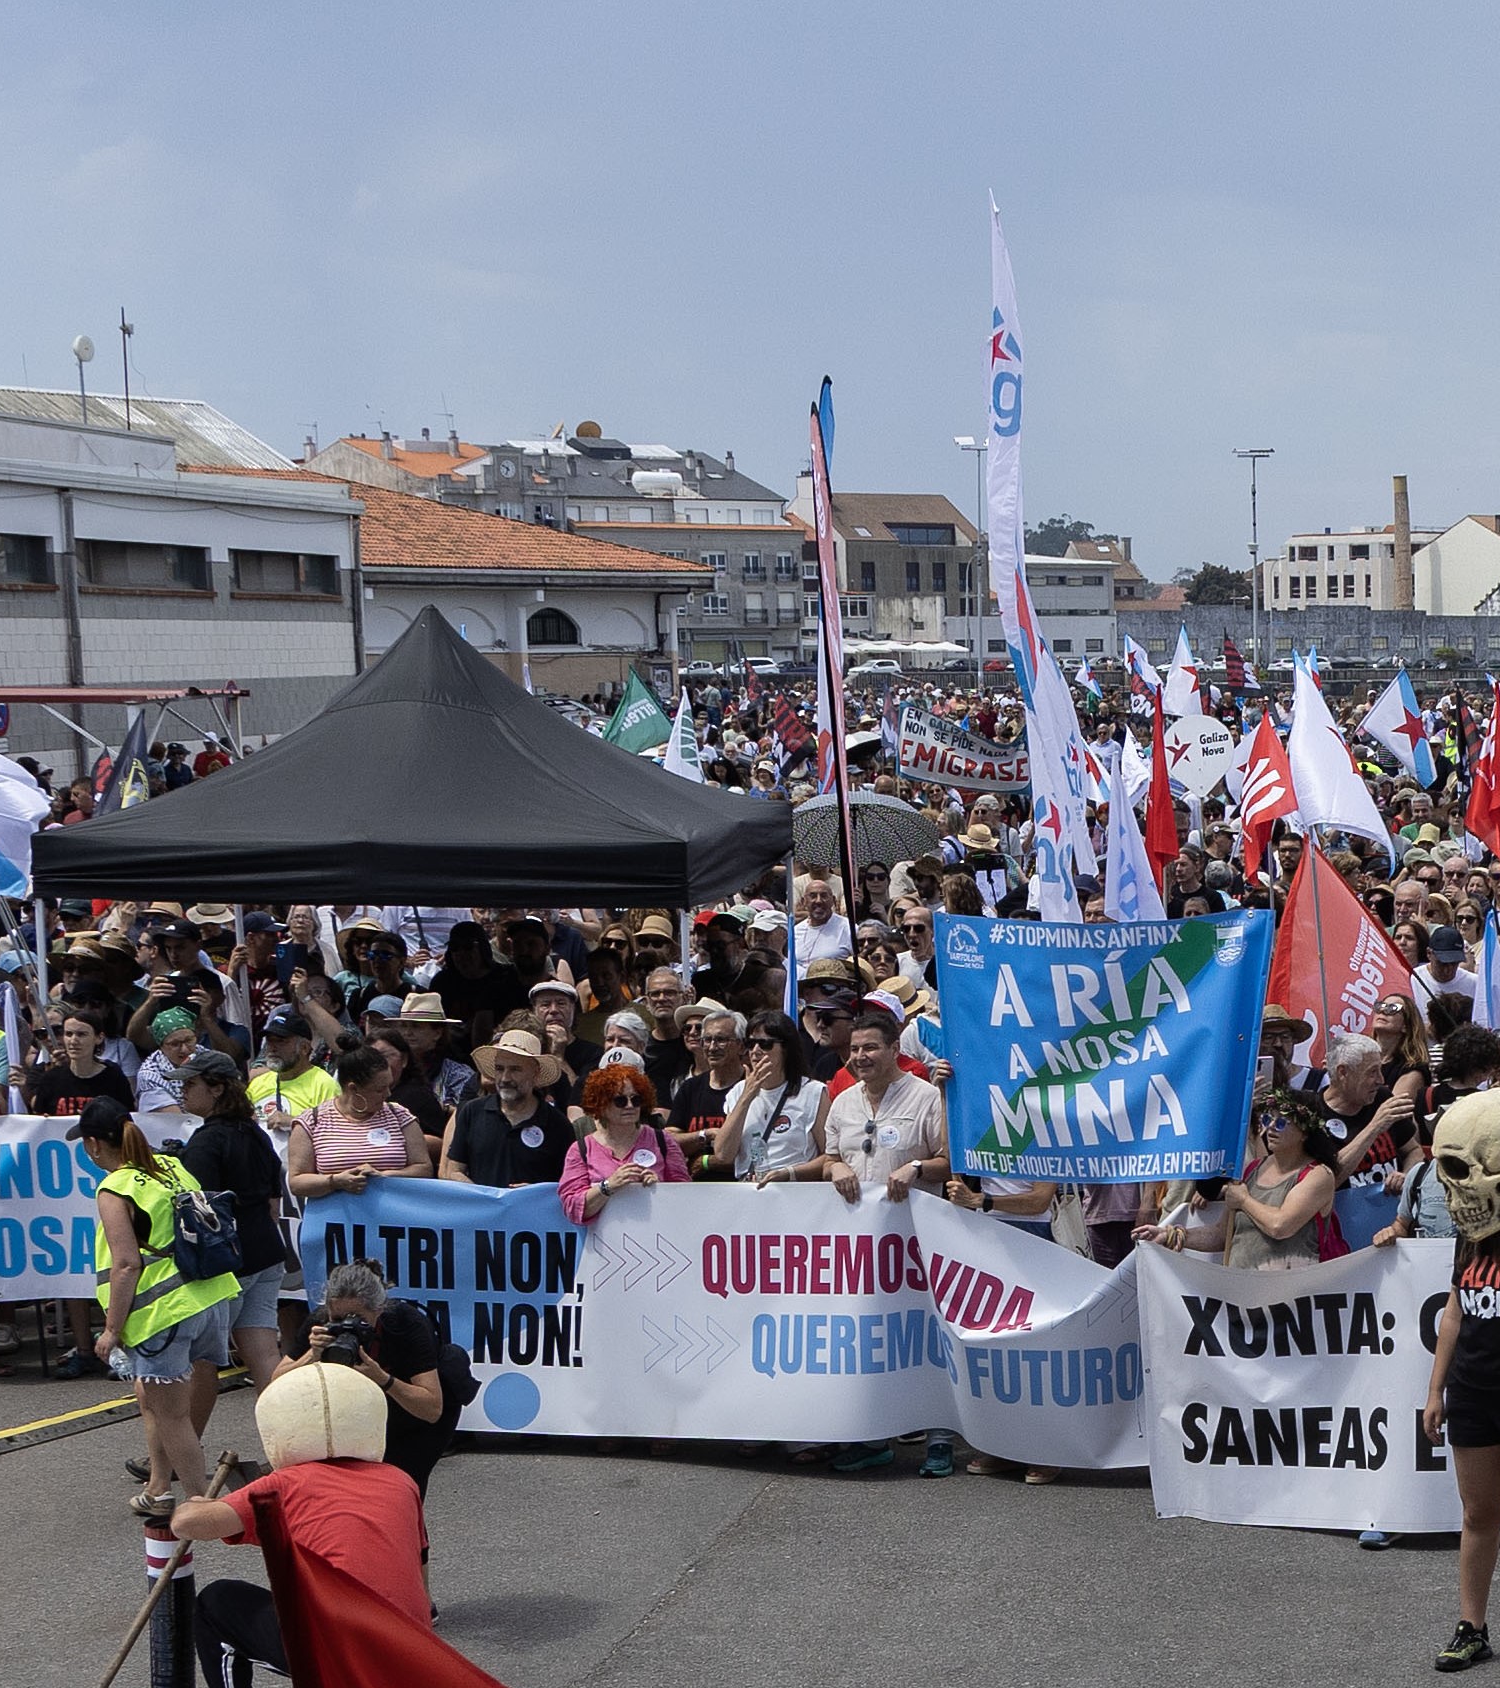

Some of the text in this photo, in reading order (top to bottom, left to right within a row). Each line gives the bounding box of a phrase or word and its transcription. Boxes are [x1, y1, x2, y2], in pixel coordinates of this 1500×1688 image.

[904, 721, 977, 754] NON SE PIDE
[906, 709, 923, 723] EN
[1199, 732, 1230, 745] Galiza
[1201, 745, 1226, 758] Nova
[990, 923, 1183, 949] #STOPMINASANFINX
[990, 949, 1192, 1028] A RÍA
[1009, 1023, 1169, 1080] A NOSA
[989, 1073, 1188, 1149] MINA
[999, 1151, 1180, 1179] DE RIQUEZA E NATUREZA EN
[474, 1229, 585, 1303] NON,
[702, 1232, 929, 1298] QUEREMOS
[472, 1303, 584, 1368] NON!
[751, 1308, 962, 1388] QUEREMOS
[1182, 1293, 1396, 1361] XUNTA:
[1182, 1403, 1389, 1470] SANEAS
